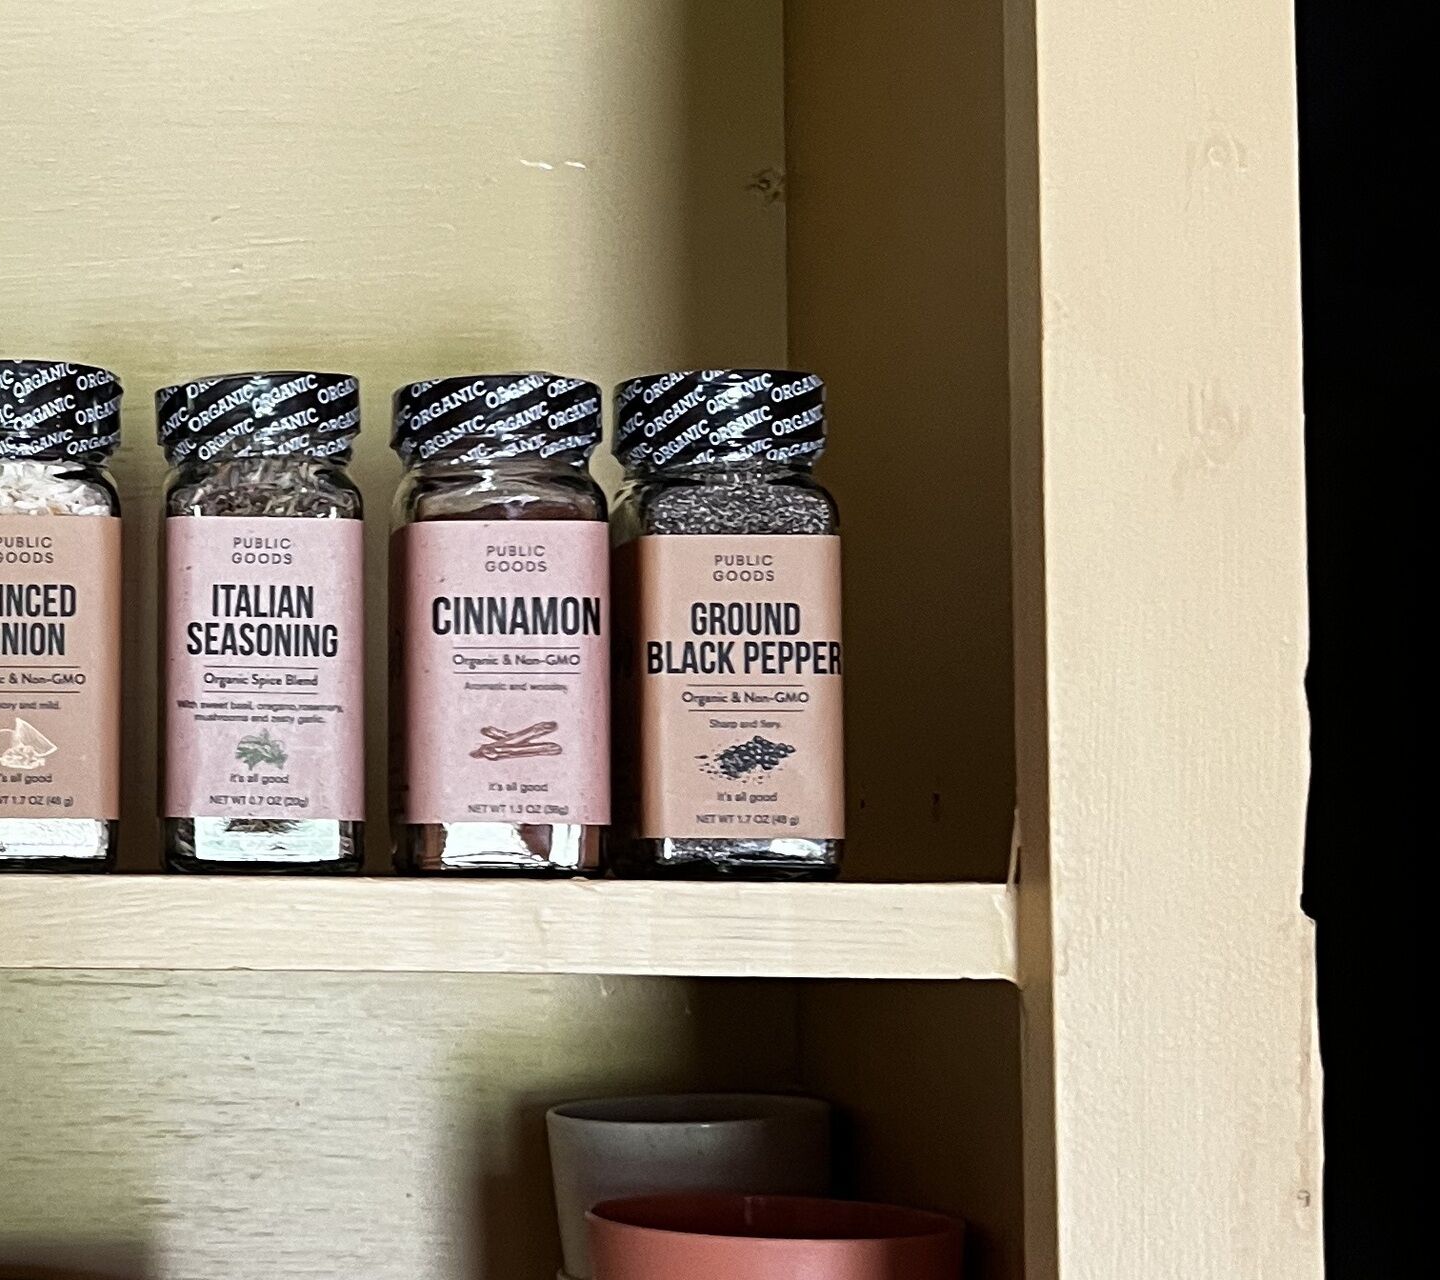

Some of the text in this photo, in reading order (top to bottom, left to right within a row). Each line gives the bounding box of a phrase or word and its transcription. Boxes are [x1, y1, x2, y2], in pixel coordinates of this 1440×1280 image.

[13, 362, 78, 399] ORGANIC
[14, 394, 76, 430] ORGANIC
[187, 384, 254, 432] ORGANIC
[410, 380, 487, 430] ORGANIC
[643, 384, 707, 438] ORGANIC
[419, 415, 486, 459] ORGANIC
[484, 401, 549, 437] ORGANIC
[652, 419, 710, 465] ORGANIC
[708, 405, 773, 445] ORGANIC
[197, 417, 255, 461] ORGANIC
[233, 537, 291, 549] PUBLIC
[486, 545, 546, 557] PUBLIC
[231, 552, 293, 565] GOODS
[485, 560, 548, 573] GOODS
[714, 555, 773, 566] PUBLIC
[713, 570, 774, 582] GOODS
[211, 584, 315, 618] ITALIAN
[431, 596, 602, 636] CINNAMON
[690, 602, 800, 636] GROUND
[186, 622, 339, 657] SEASONING
[452, 654, 580, 669] Organic & Non-GMO
[647, 641, 843, 675] BLACK PEPPER
[8, 672, 18, 684] &
[21, 673, 86, 685] Non-GMO
[204, 672, 318, 689] Organic Spice Blend
[682, 692, 809, 707] Organic & Non-GMO
[24, 773, 53, 785] good
[261, 774, 290, 785] good
[520, 783, 548, 794] good
[28, 795, 44, 805] OZ
[749, 792, 778, 803] good
